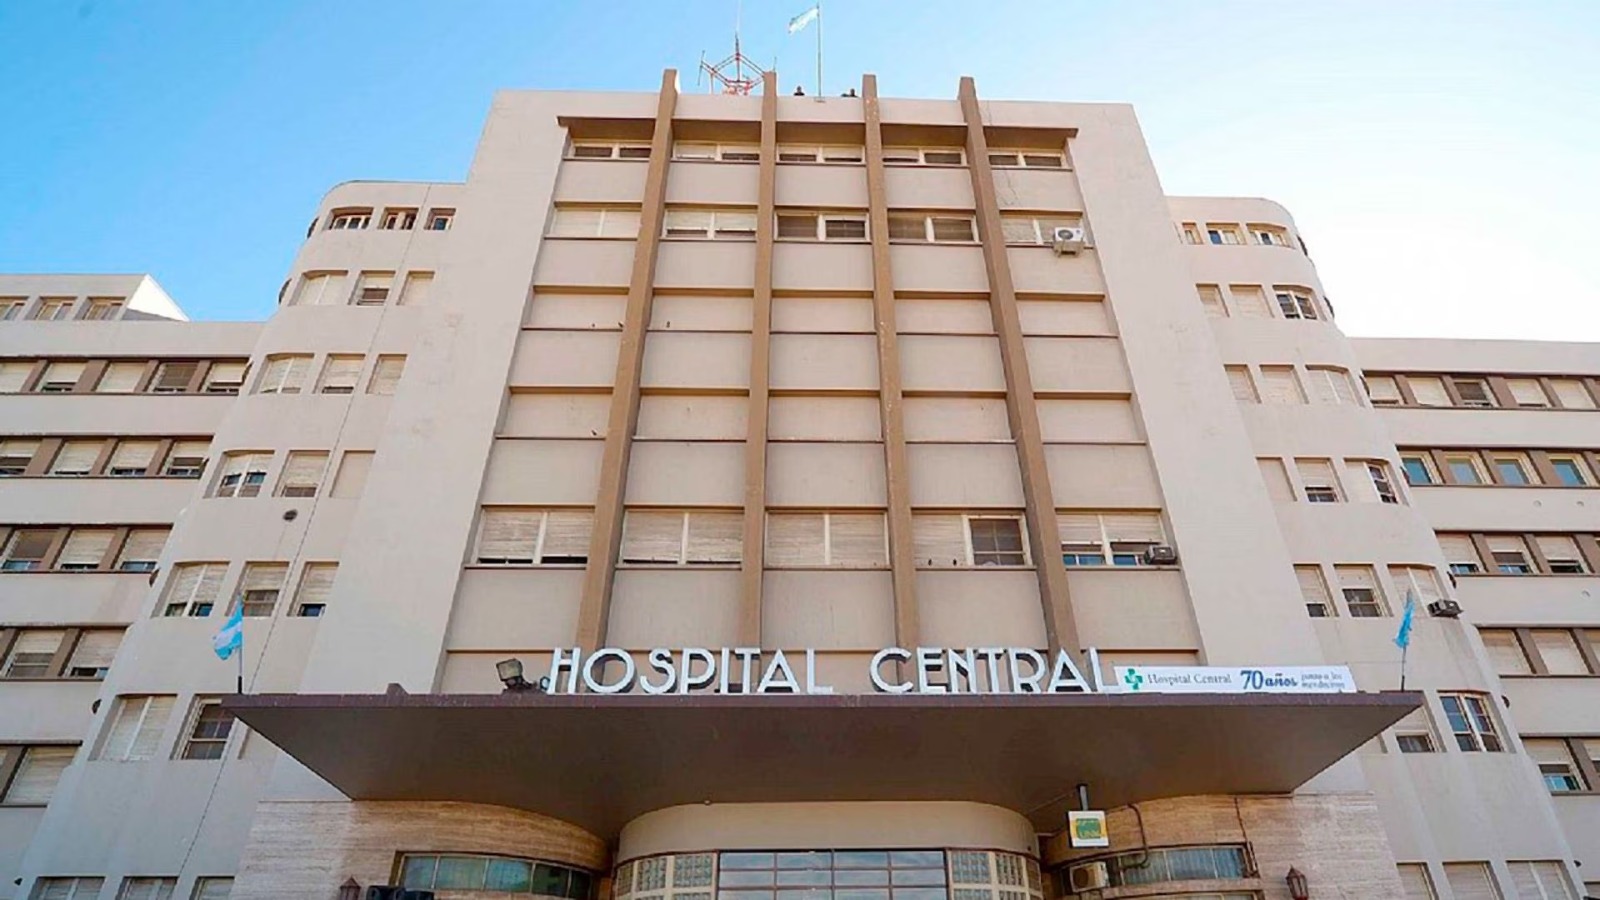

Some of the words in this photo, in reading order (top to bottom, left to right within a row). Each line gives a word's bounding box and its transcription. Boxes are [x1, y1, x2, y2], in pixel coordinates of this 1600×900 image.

[546, 647, 834, 695] HOSPITAL
[869, 647, 1123, 694] CENTRAL
[1147, 674, 1192, 686] Hospital
[1194, 674, 1232, 684] Central
[1240, 670, 1264, 690] 70
[1265, 672, 1298, 687] años
